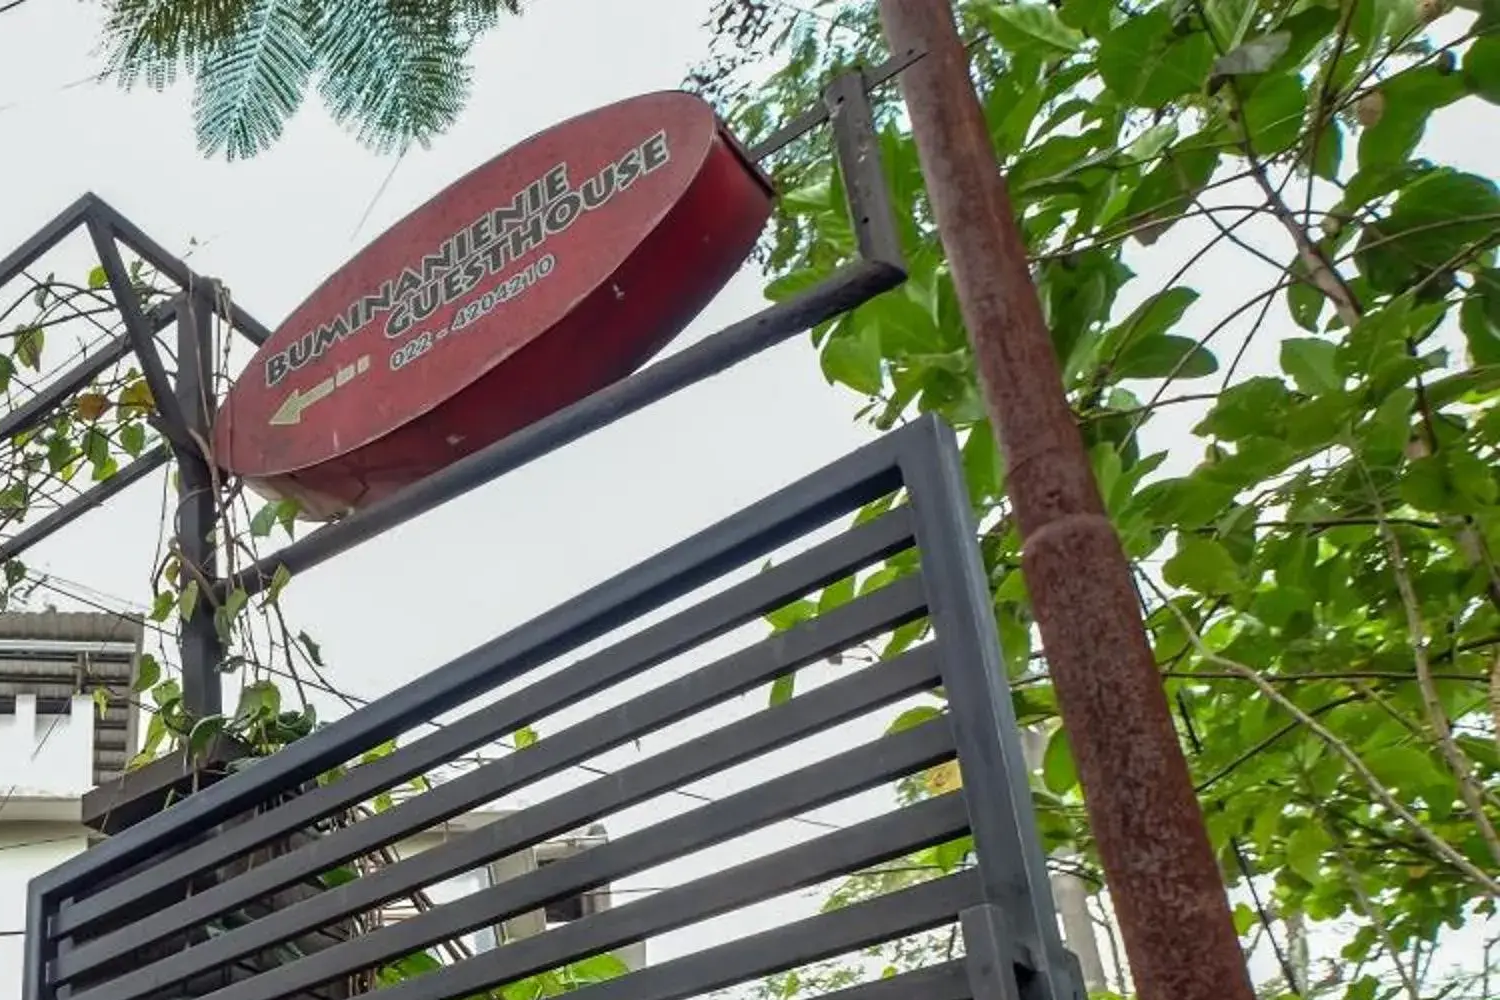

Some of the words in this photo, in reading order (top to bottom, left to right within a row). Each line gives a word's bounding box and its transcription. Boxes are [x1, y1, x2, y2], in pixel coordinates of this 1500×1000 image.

[266, 163, 570, 387] BUMINANIENIE
[384, 129, 670, 339] GUESTHOUSE
[390, 332, 433, 371] 022
[451, 254, 556, 332] 4204210
